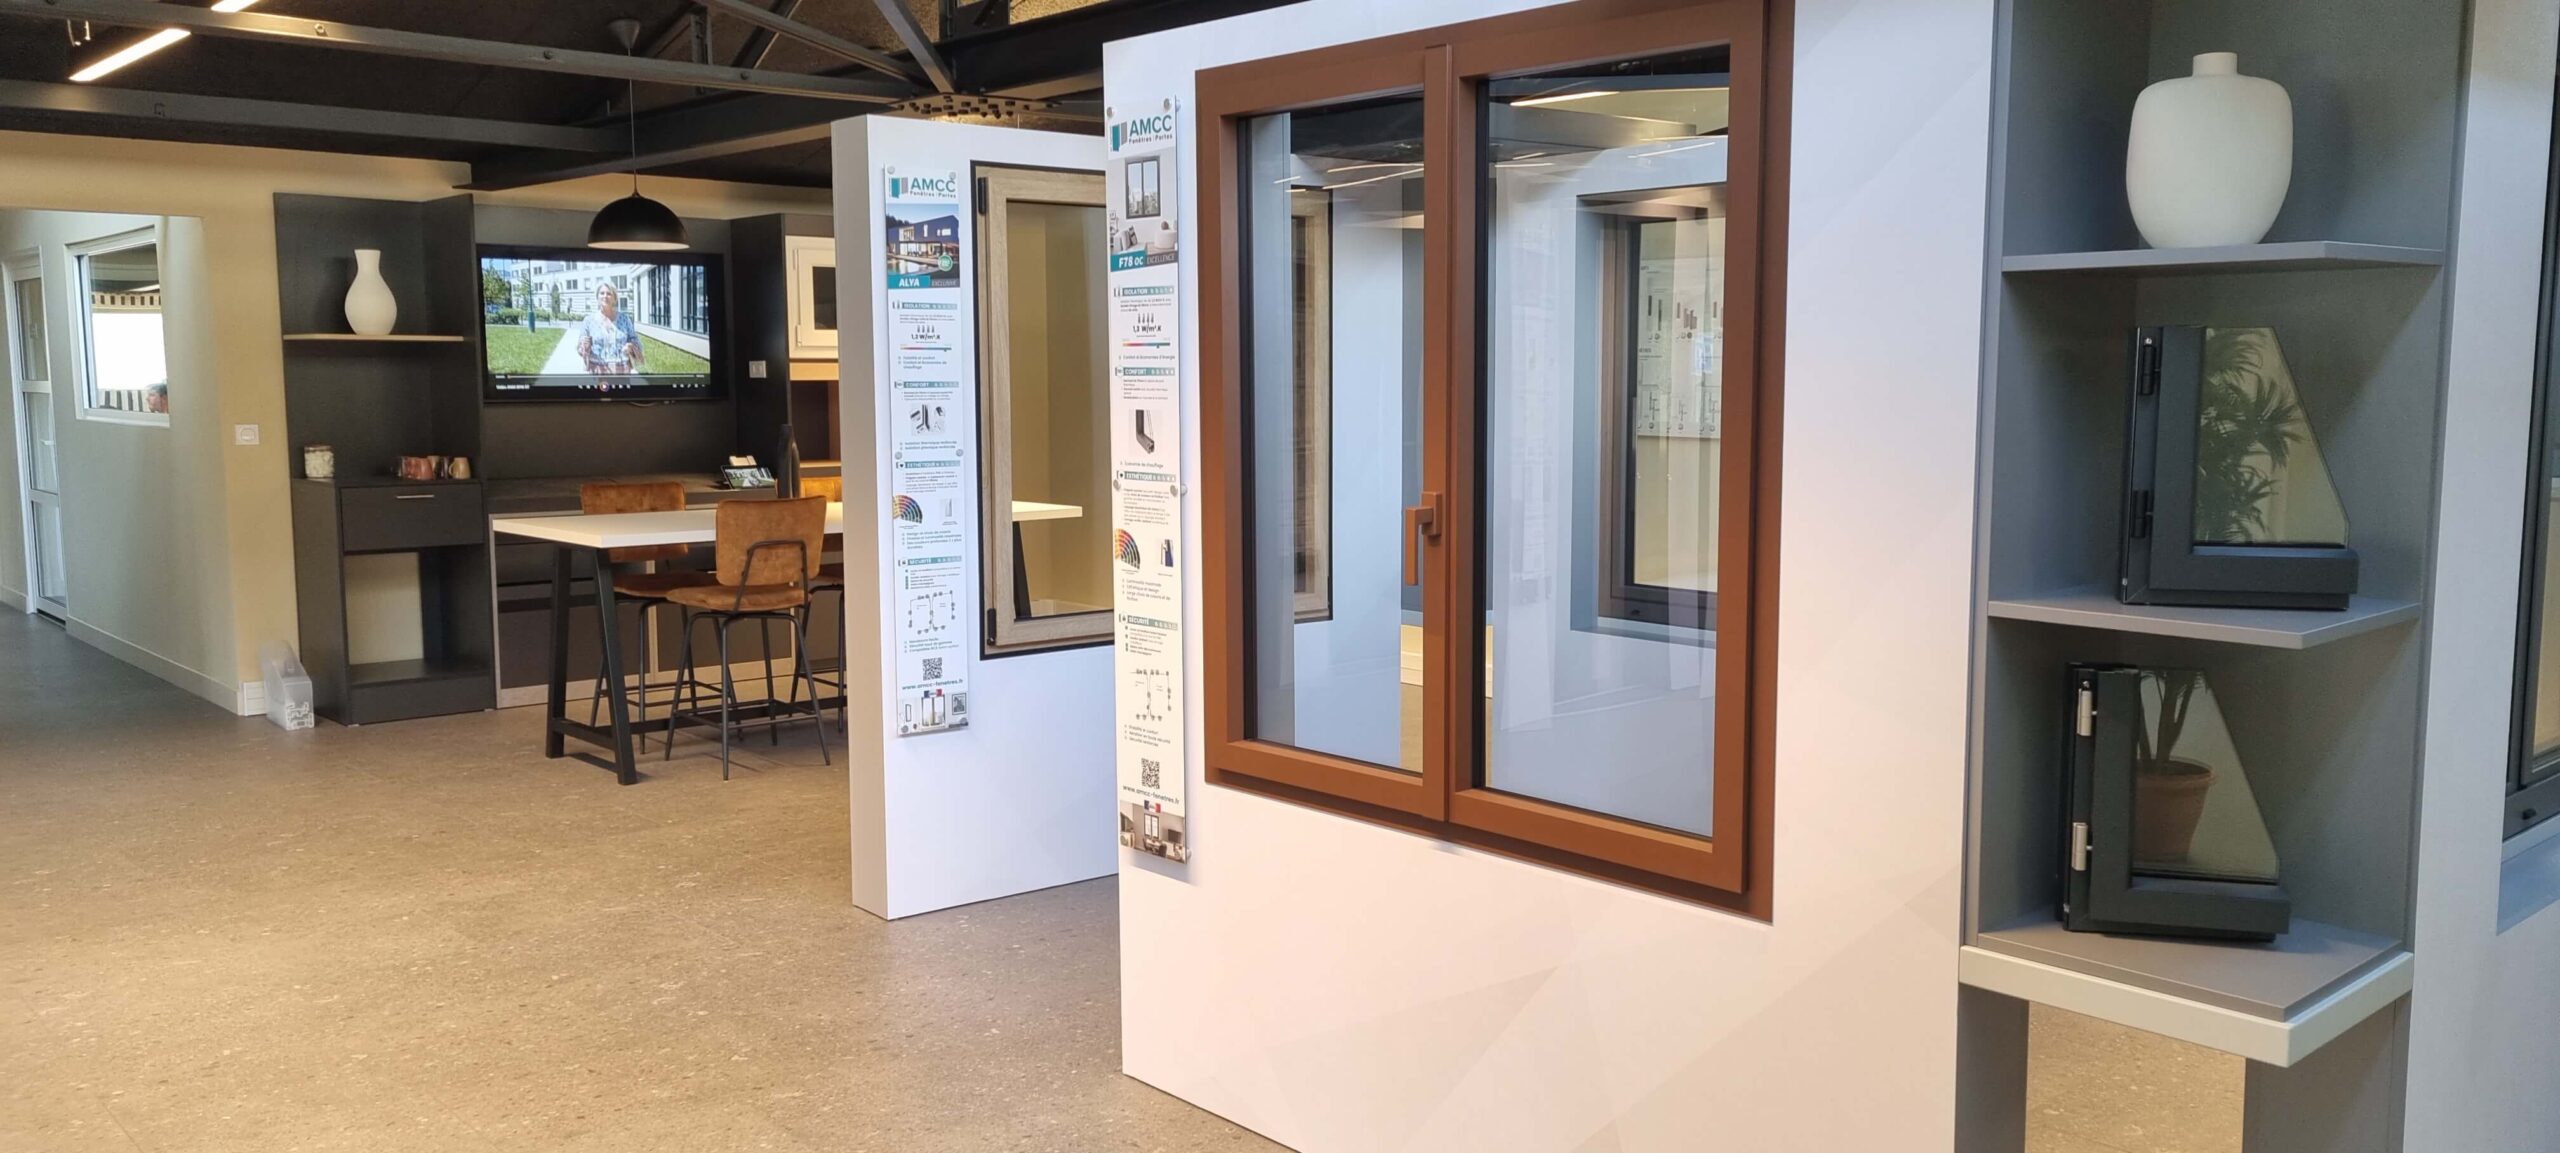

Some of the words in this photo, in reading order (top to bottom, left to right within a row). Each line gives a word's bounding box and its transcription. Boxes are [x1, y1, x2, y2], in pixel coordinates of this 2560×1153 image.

[1129, 115, 1172, 137] AMCC
[911, 177, 956, 193] AMCC
[1118, 256, 1133, 269] F78
[1134, 256, 1144, 267] OC
[898, 278, 920, 288] ALYA
[1123, 288, 1148, 296] ISOLATION
[1124, 367, 1147, 376] CONFORT
